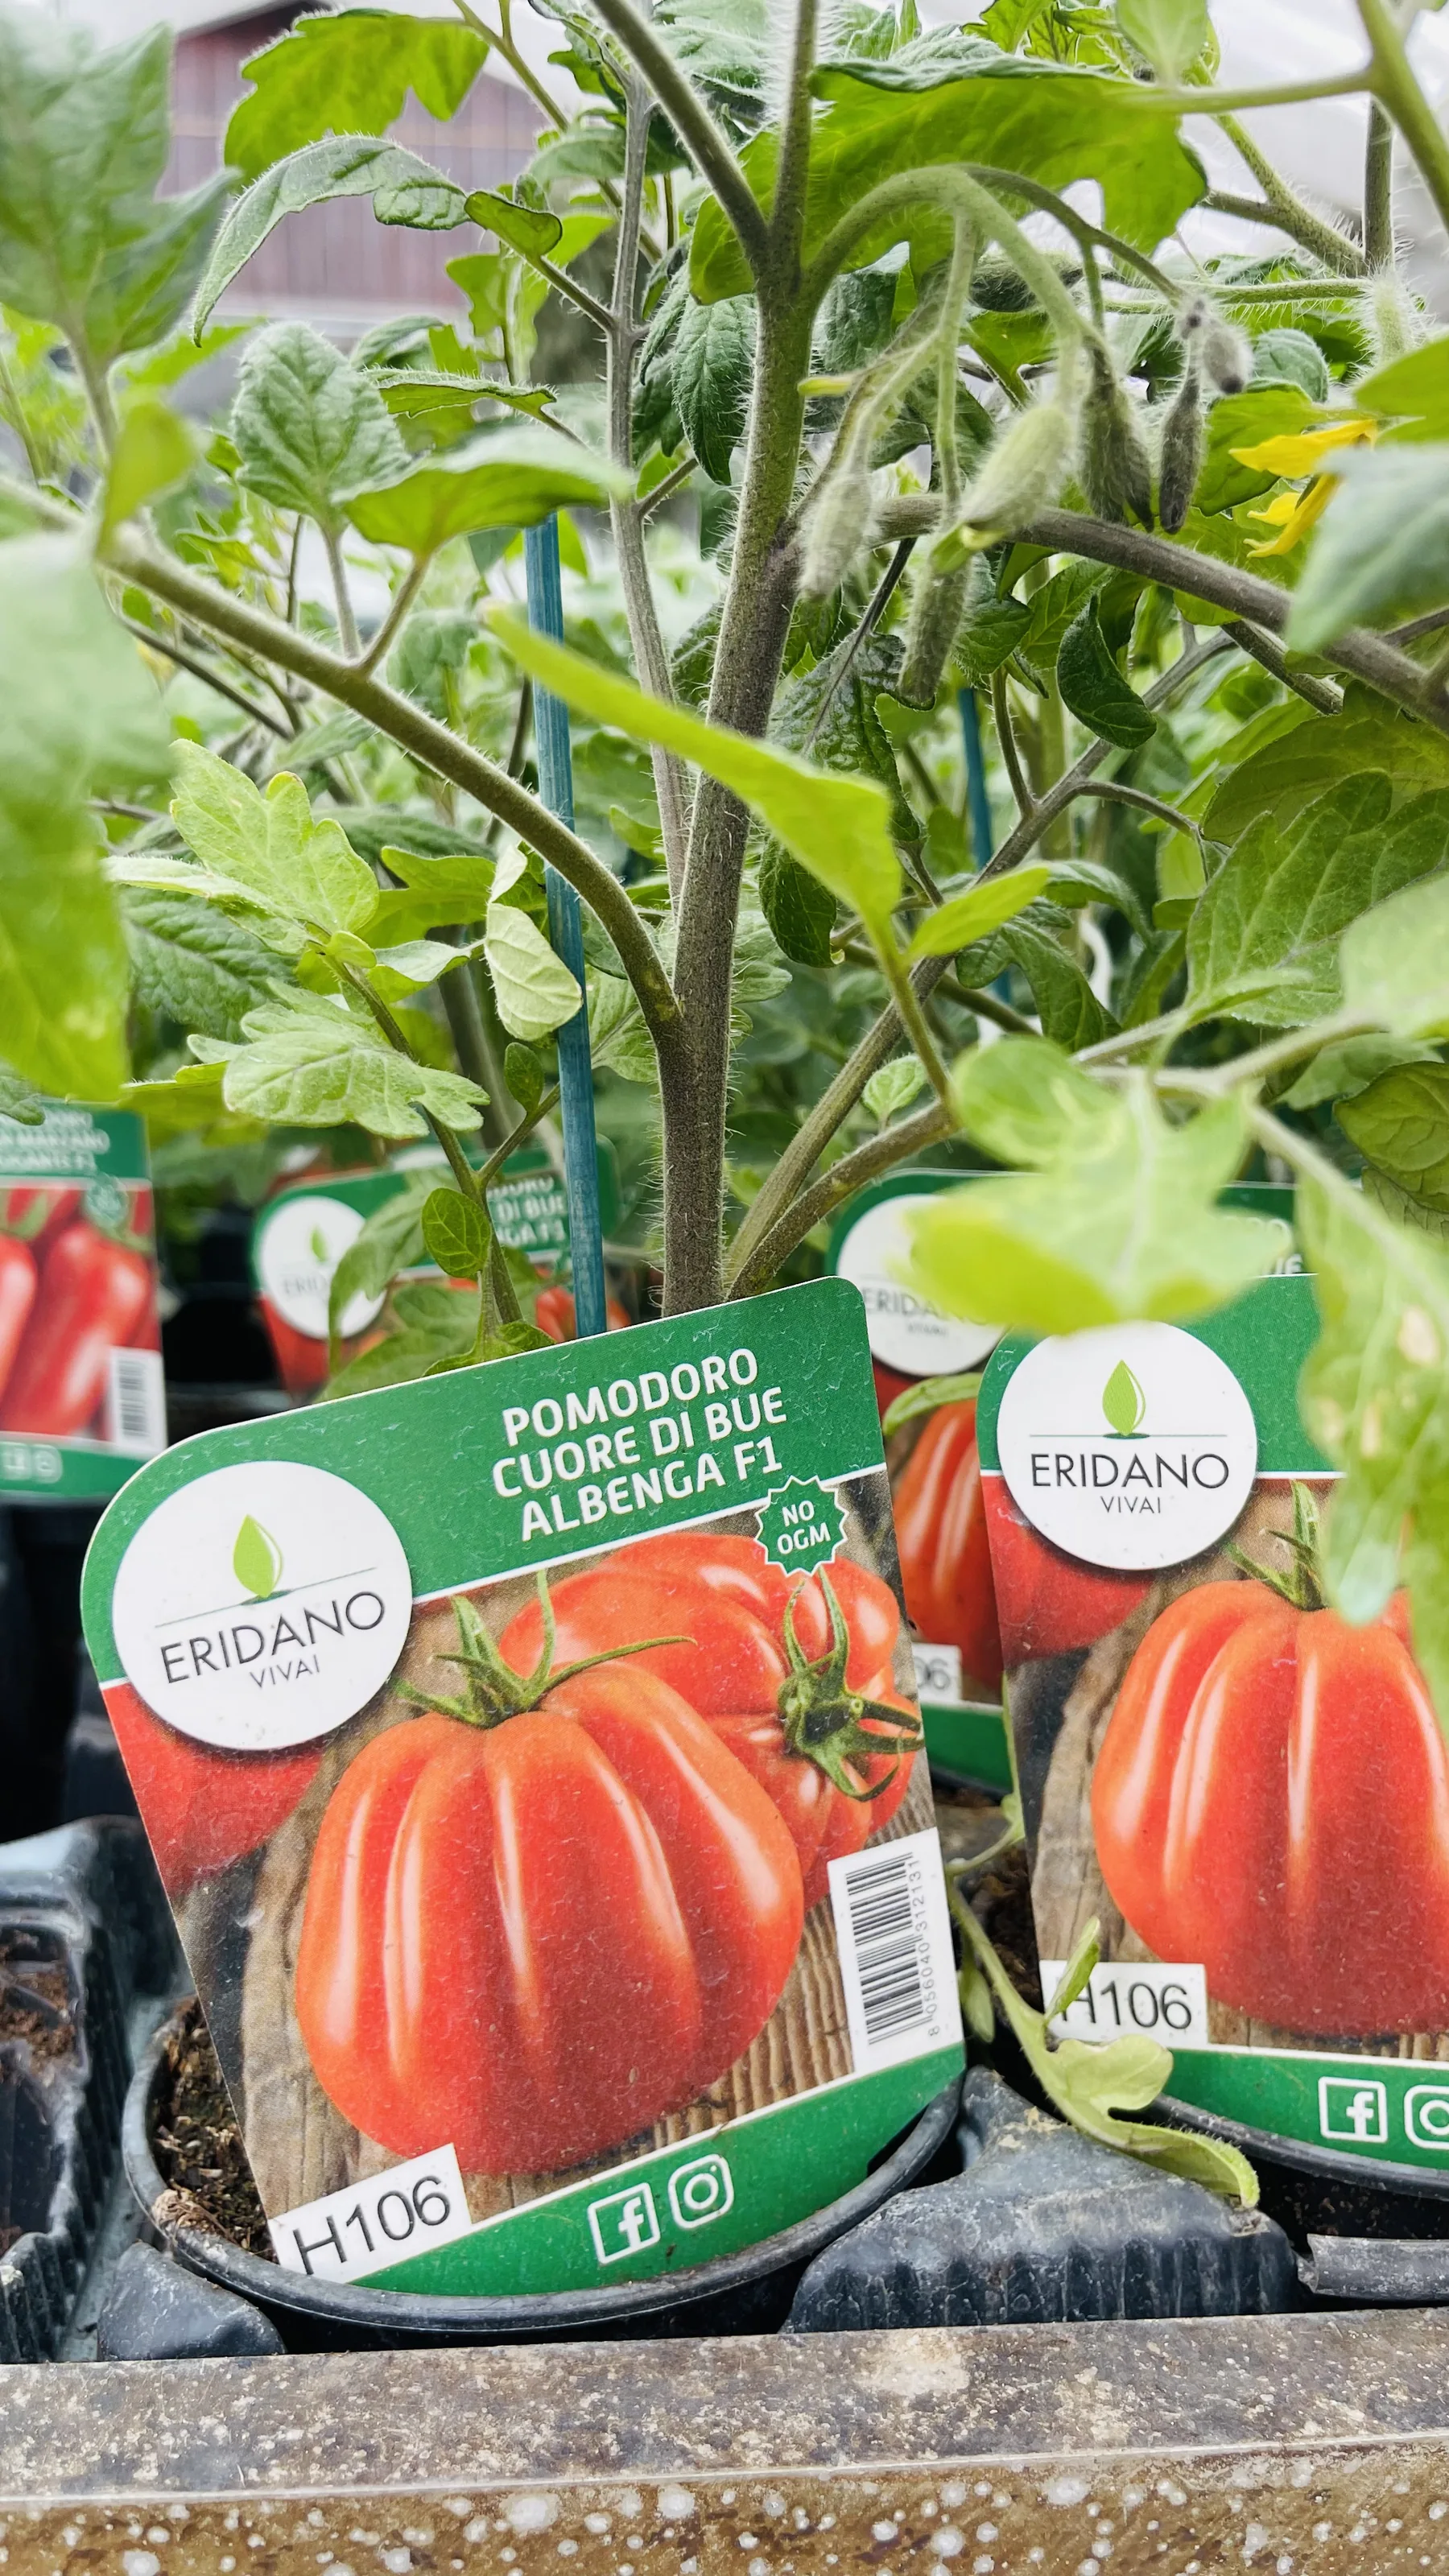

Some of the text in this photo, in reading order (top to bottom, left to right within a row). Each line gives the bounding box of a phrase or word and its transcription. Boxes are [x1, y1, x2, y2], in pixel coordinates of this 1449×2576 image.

[502, 1348, 758, 1447] POMODORO
[493, 1386, 787, 1498] CUORE DI BUE
[1030, 1452, 1230, 1489] ERIDANO
[521, 1435, 783, 1542] ALBENGA F1
[781, 1500, 816, 1528] NO
[1100, 1496, 1162, 1514] VIVAI
[777, 1521, 832, 1555] OGM
[160, 1591, 386, 1684] ERIDANO
[249, 1653, 322, 1689] VIVAI
[292, 2174, 452, 2277] H106
